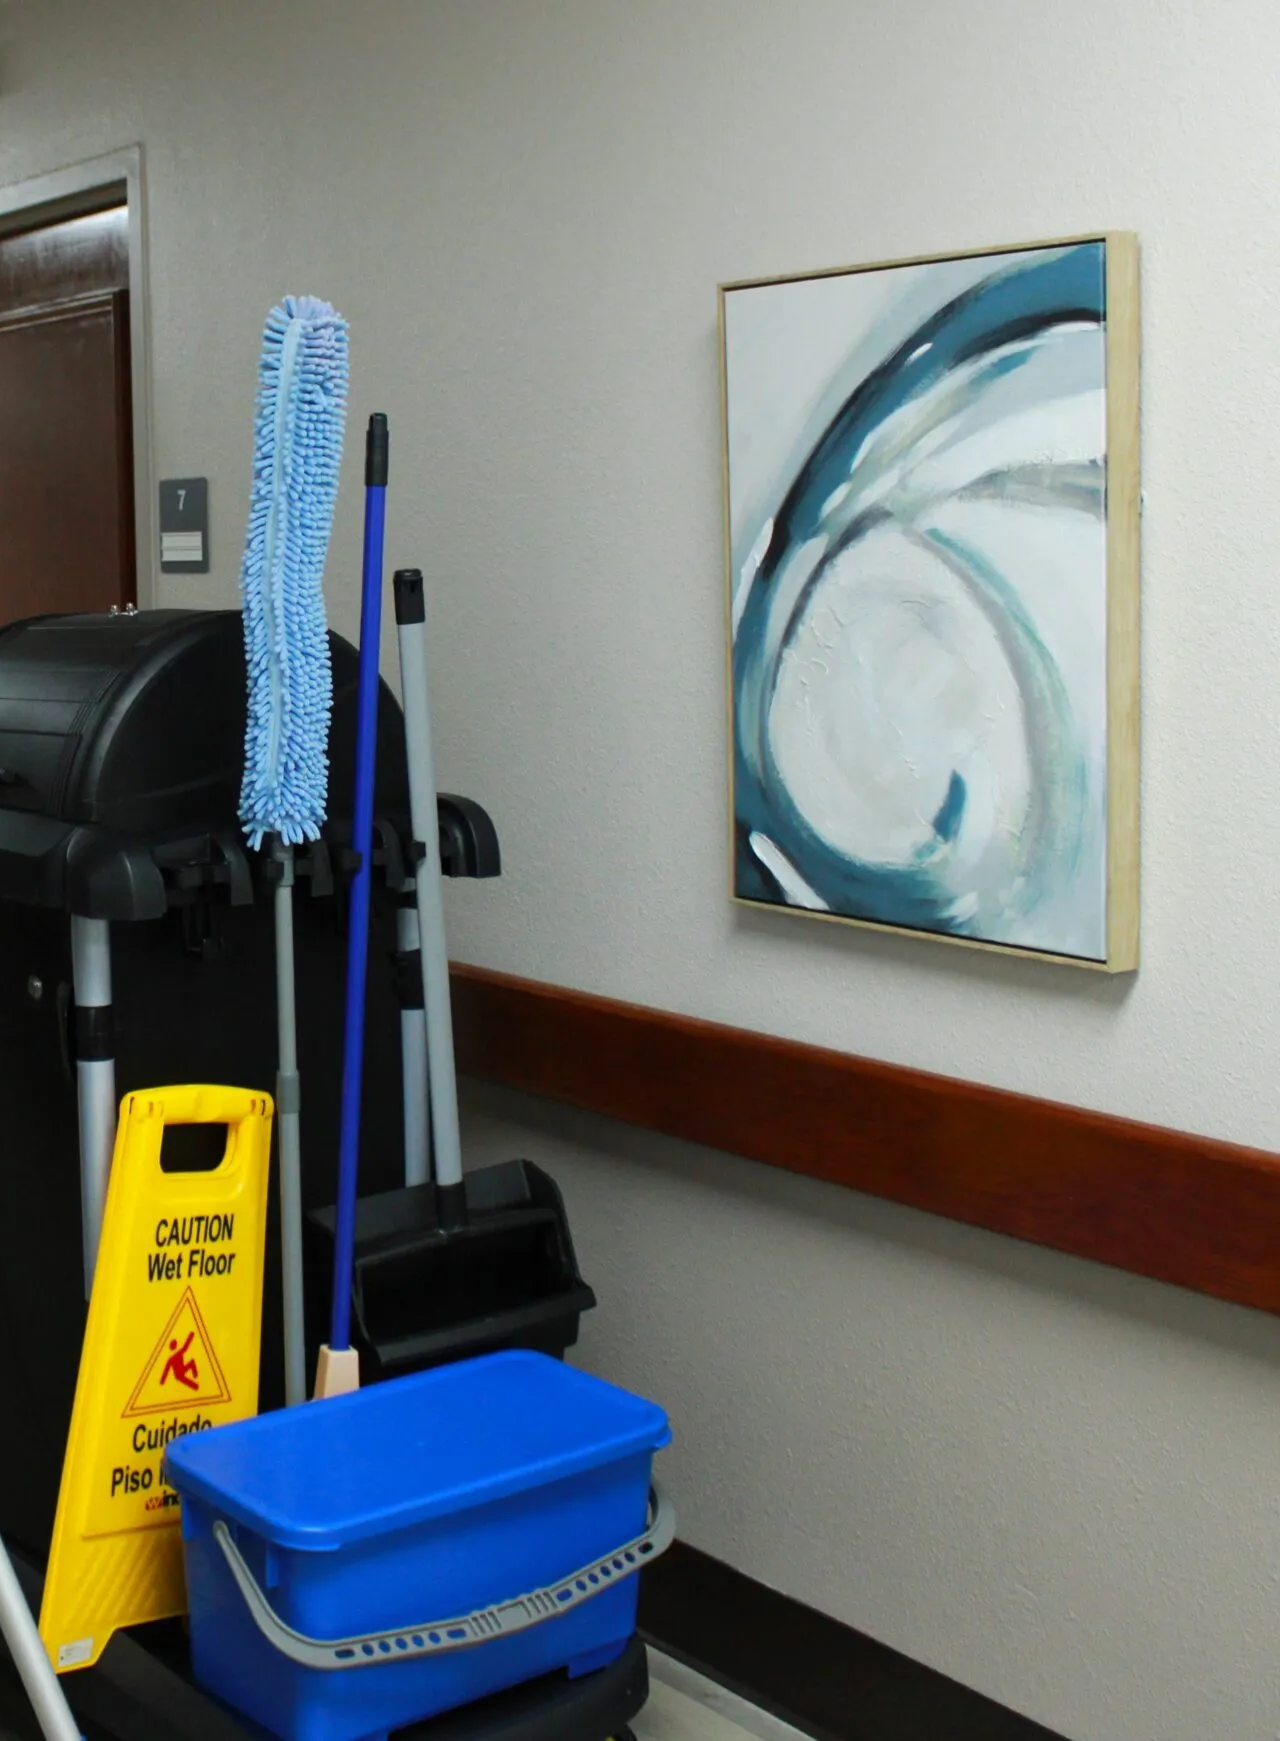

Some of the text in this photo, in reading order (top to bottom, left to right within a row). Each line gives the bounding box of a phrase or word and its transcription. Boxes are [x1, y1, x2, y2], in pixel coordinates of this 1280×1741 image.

[177, 489, 186, 510] 7
[155, 1213, 235, 1248] CAUTION
[147, 1248, 236, 1283] Wet Floor
[111, 1464, 153, 1498] Piso
